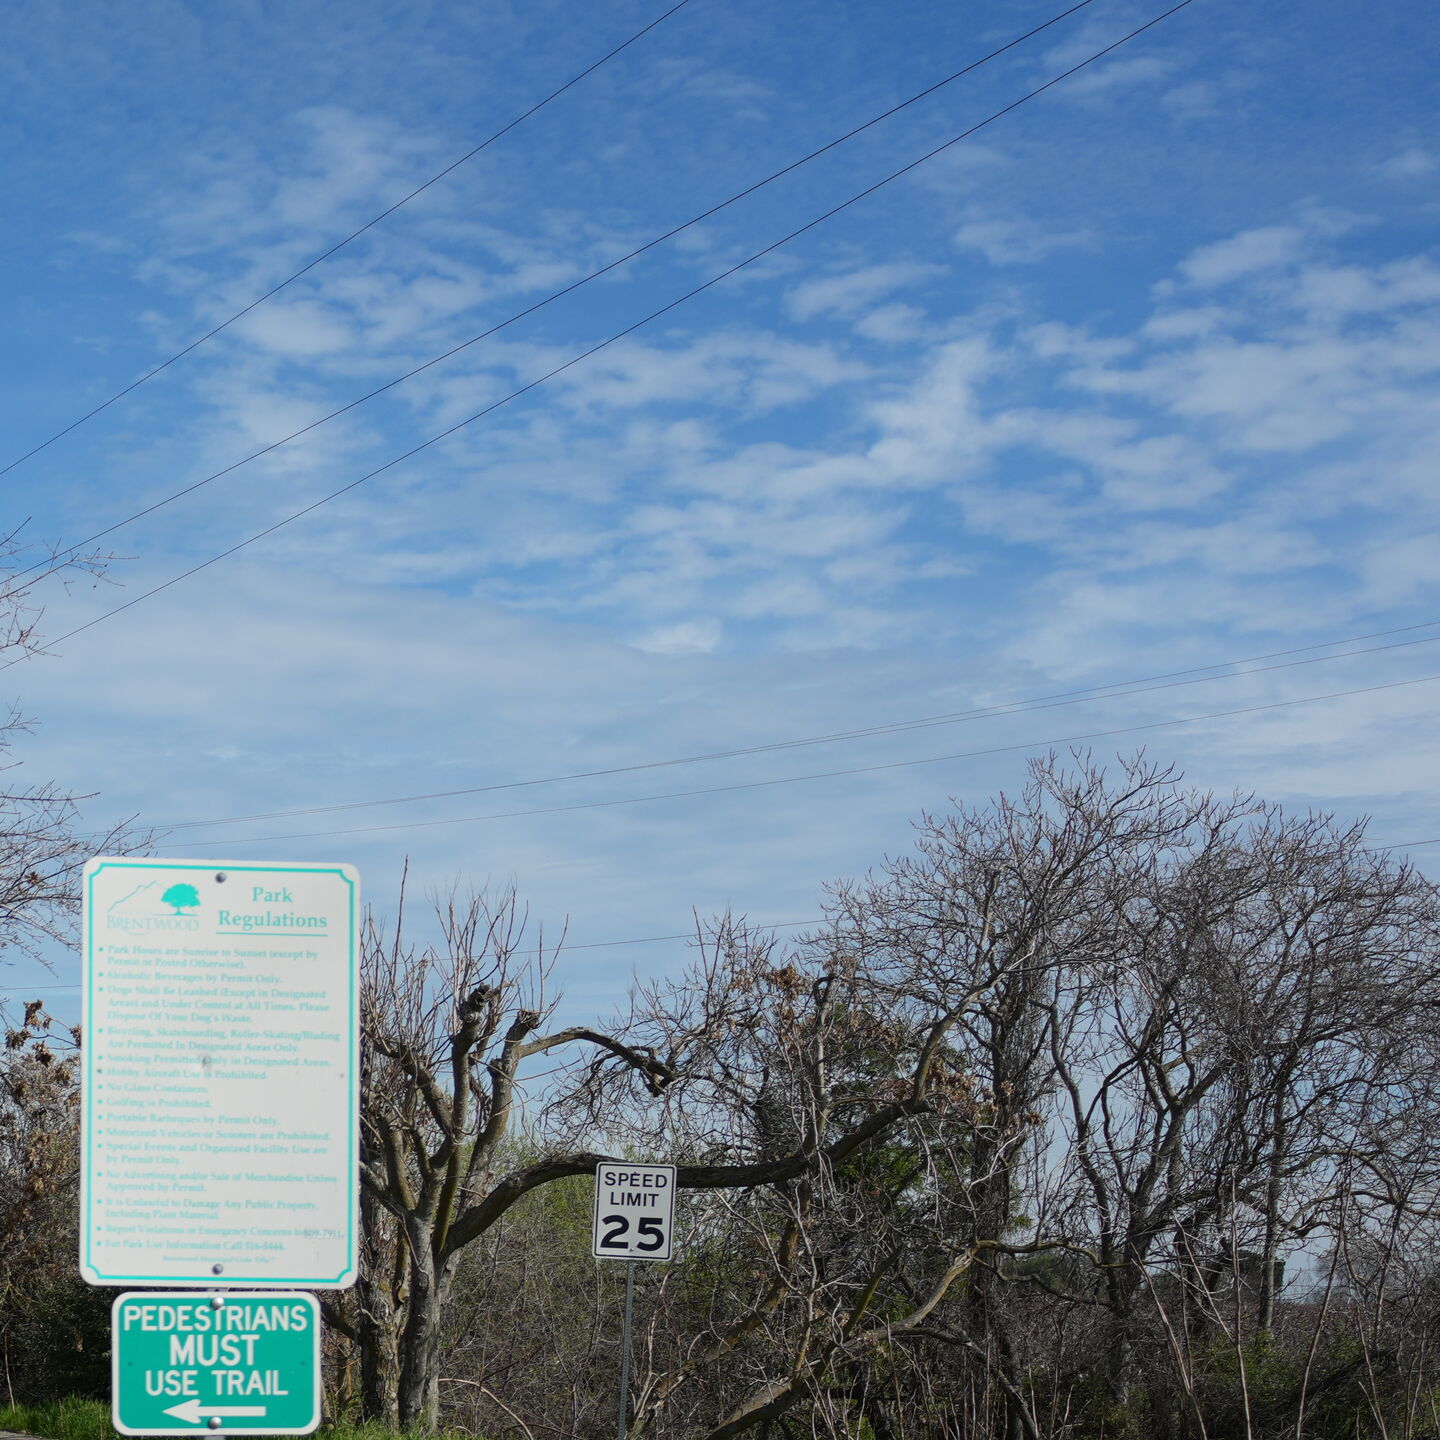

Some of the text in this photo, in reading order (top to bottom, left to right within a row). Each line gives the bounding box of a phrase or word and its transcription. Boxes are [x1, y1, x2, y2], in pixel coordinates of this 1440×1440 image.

[252, 887, 293, 902] Park
[106, 915, 200, 932] BRENTWOOD
[218, 910, 328, 930] Regulations
[604, 1172, 668, 1188] SPEED
[610, 1192, 659, 1207] LIMIT
[600, 1215, 665, 1252] 25
[123, 1305, 308, 1331] PEDESTRIANS
[169, 1334, 260, 1366] MUST
[145, 1370, 288, 1396] USE TRAIL
